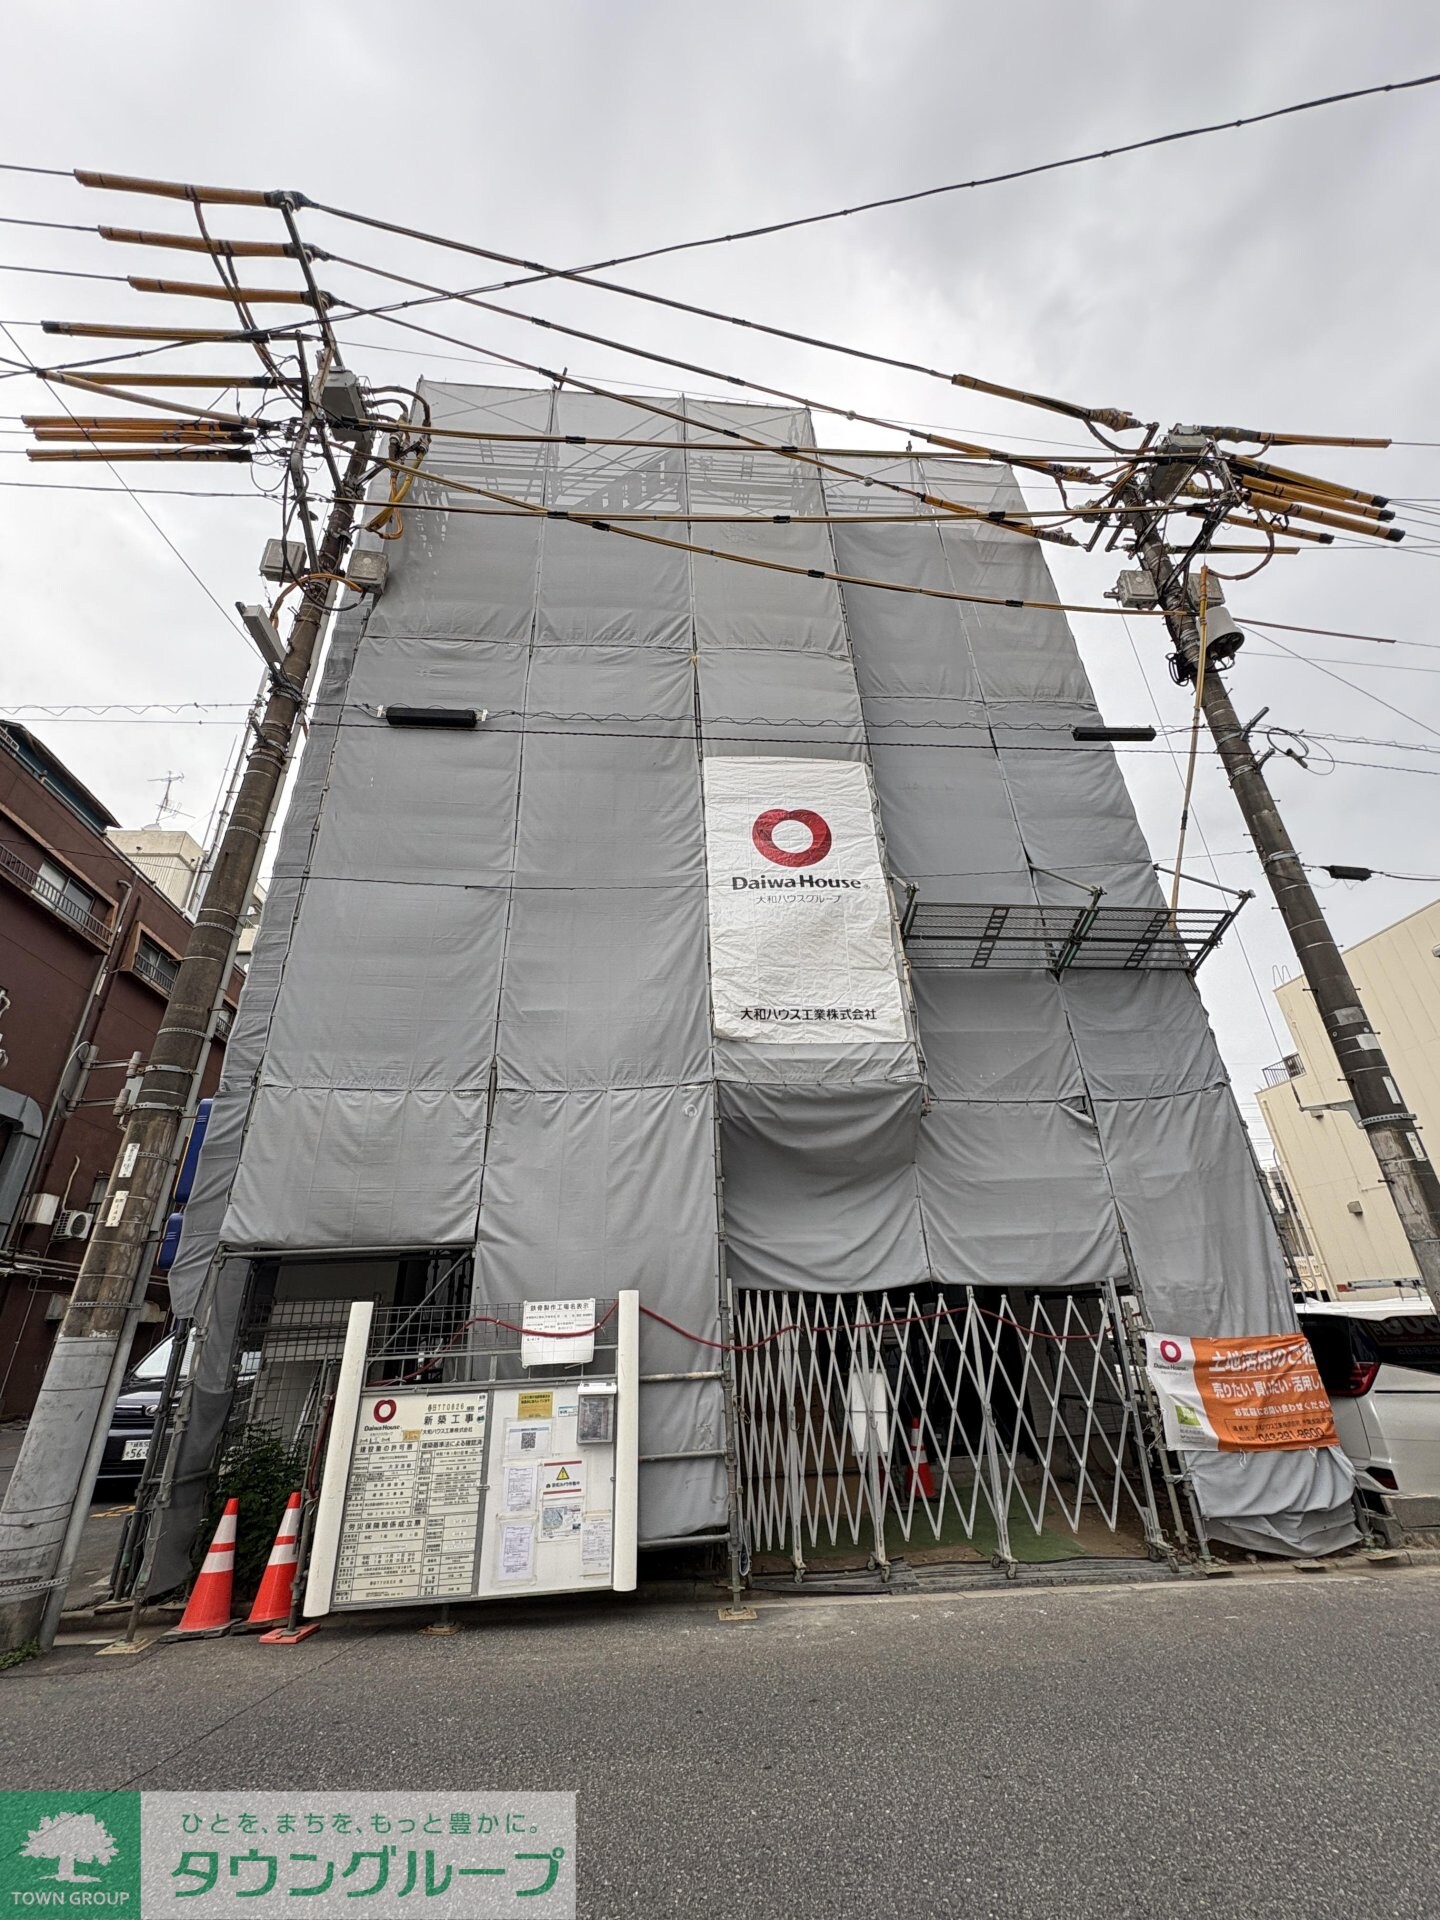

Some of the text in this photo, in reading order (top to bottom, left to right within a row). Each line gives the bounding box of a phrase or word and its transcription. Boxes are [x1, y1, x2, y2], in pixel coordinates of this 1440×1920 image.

[732, 874, 861, 891] Daiwa House
[756, 894, 842, 904] 大和ハウスグループ
[740, 1007, 877, 1020] 大和ハウス工業株式会社
[423, 1413, 474, 1425] 新築工事
